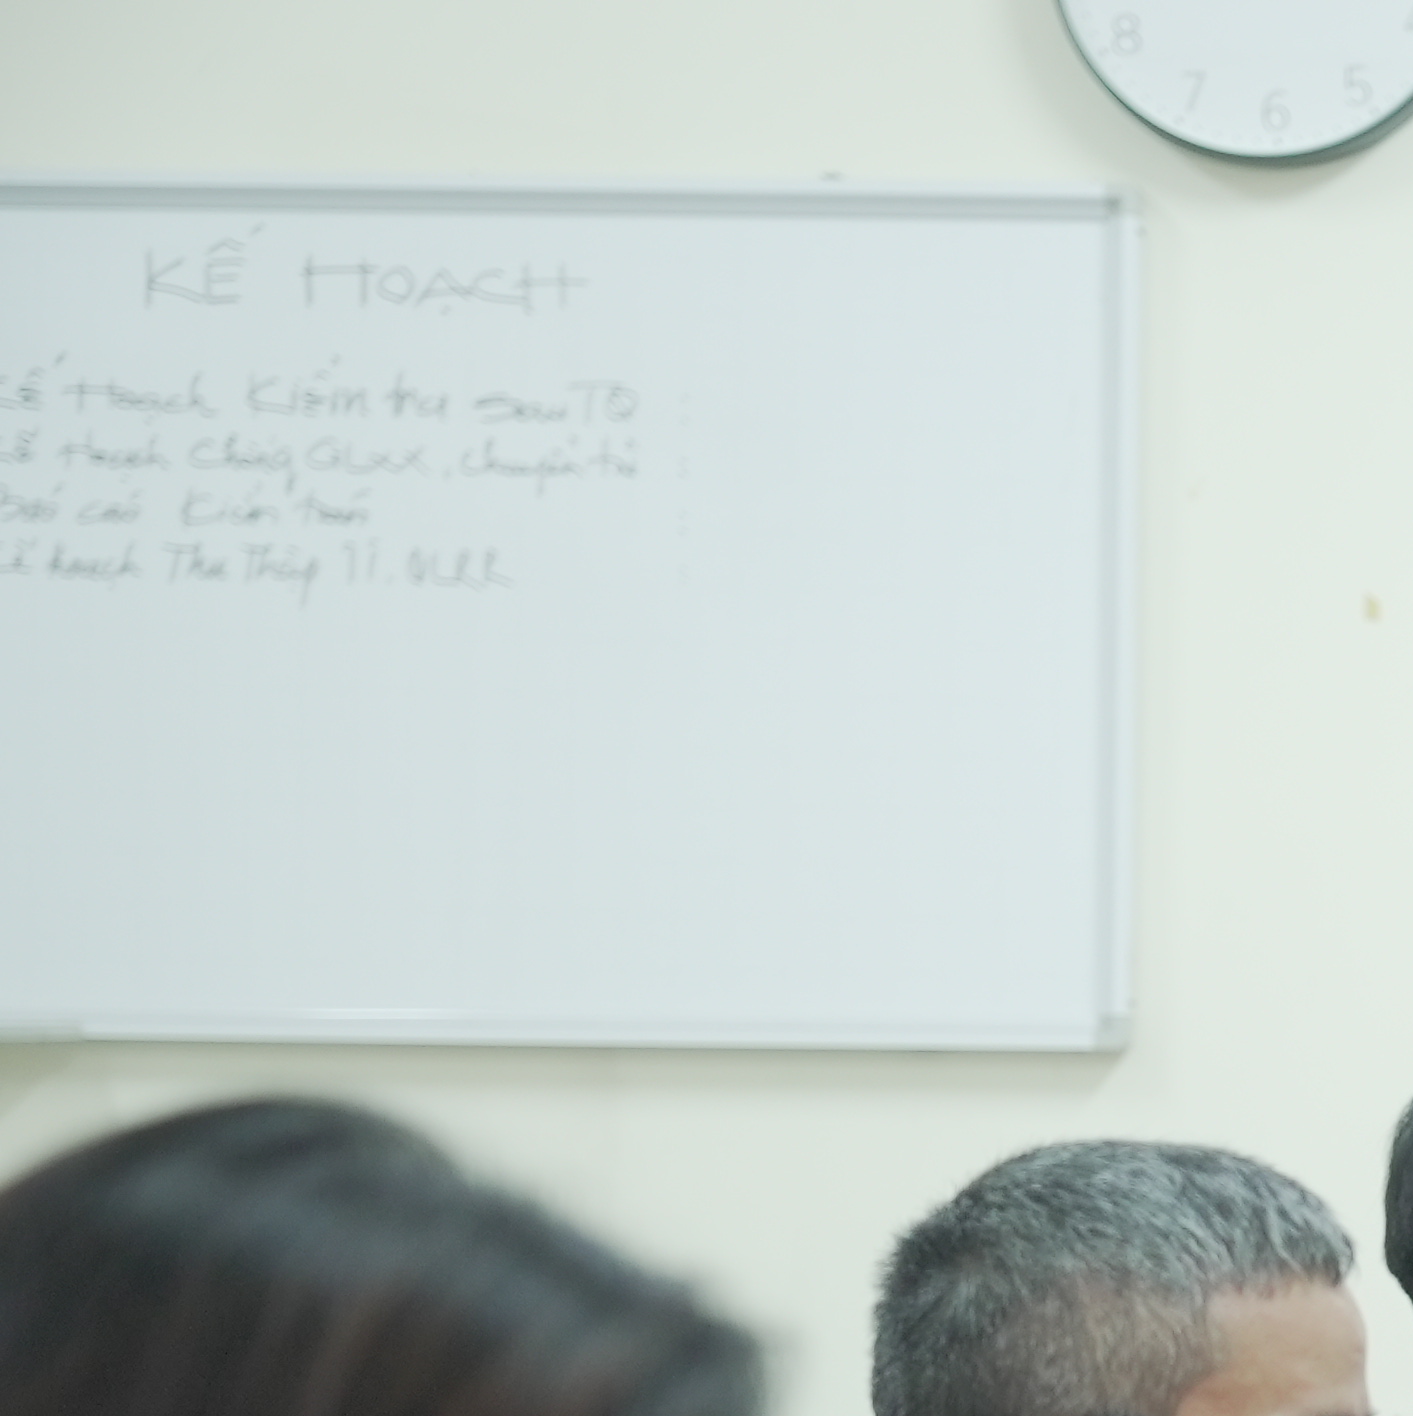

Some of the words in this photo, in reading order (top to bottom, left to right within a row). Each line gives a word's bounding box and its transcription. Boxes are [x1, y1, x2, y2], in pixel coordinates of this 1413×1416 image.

[1110, 12, 1144, 57] 8
[1183, 69, 1208, 114] 7
[1343, 63, 1374, 108] 5
[1259, 87, 1293, 134] 6
[145, 222, 267, 310] KẾ
[299, 253, 593, 317] HOẠCH
